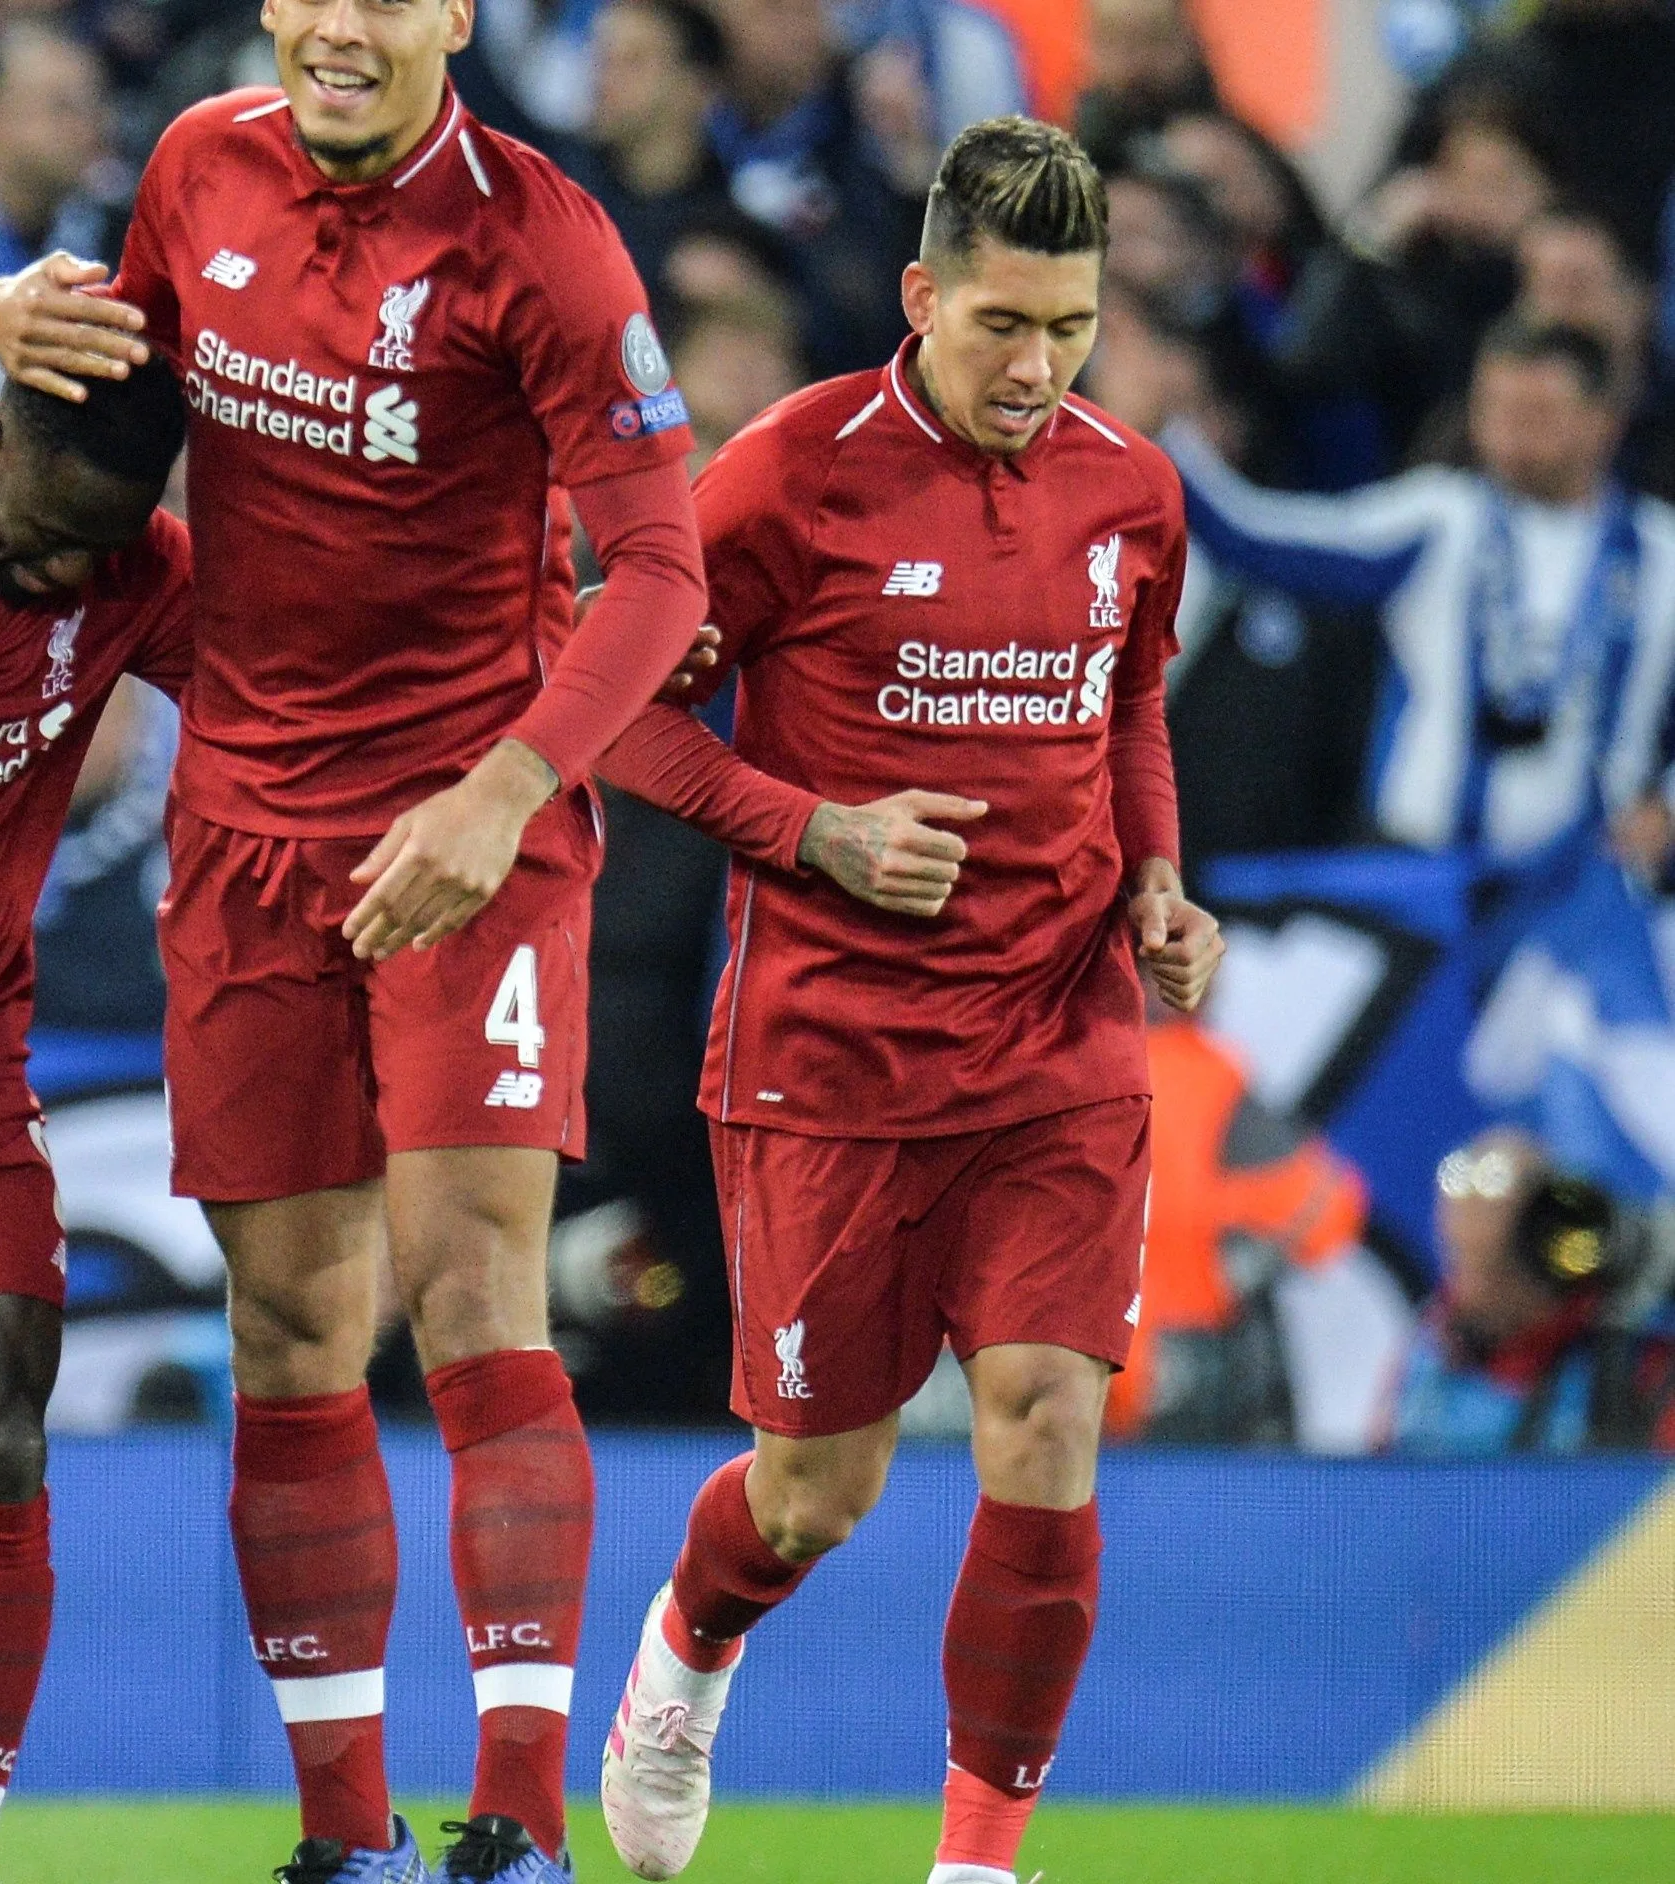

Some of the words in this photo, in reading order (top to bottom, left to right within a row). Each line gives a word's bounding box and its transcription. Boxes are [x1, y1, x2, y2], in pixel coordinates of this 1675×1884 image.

[194, 328, 357, 414] Standard
[185, 370, 354, 456] Chartered
[896, 641, 1078, 680] Standard
[877, 684, 1074, 726] Chartered
[484, 944, 545, 1068] 4
[466, 1622, 552, 1654] L.F.C.
